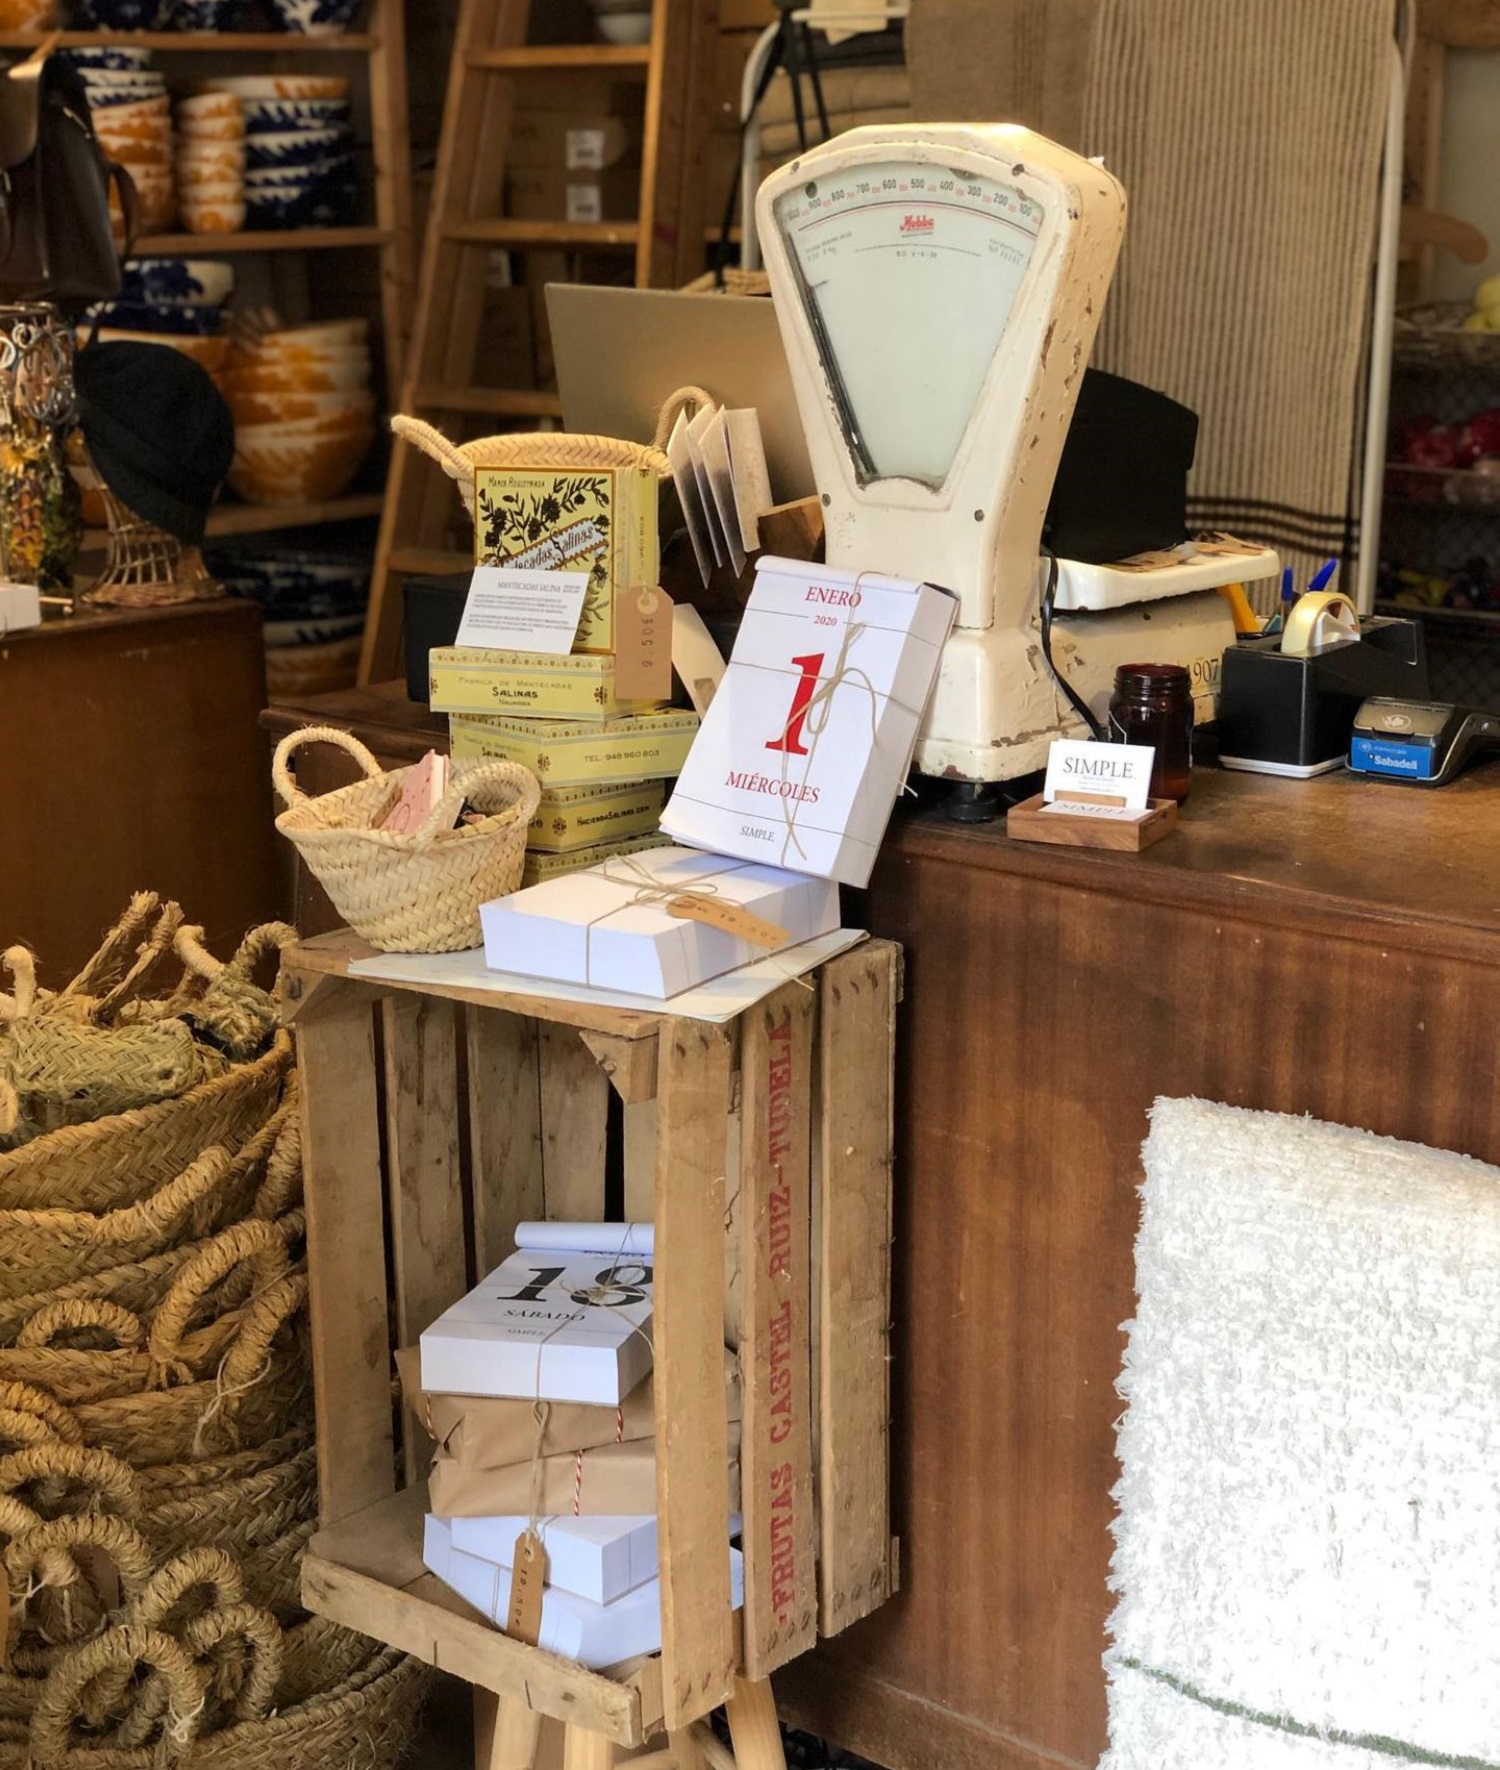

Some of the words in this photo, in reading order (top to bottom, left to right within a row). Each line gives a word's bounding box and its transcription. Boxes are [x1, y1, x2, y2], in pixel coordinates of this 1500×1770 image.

[831, 189, 845, 202] 800
[856, 182, 870, 194] 700
[882, 179, 896, 190] 600
[911, 179, 925, 190] 500
[939, 181, 954, 192] 400
[967, 185, 982, 198] 300
[993, 193, 1008, 207] 200
[1019, 203, 1033, 217] 100
[804, 586, 862, 608] ENERO
[814, 614, 837, 627] 2020
[765, 652, 825, 756] 1
[605, 751, 623, 761] 948
[623, 750, 641, 760] 960
[642, 748, 660, 758] 803
[1374, 754, 1418, 770] Sabadell
[725, 771, 820, 804] MIÉRCOLES
[497, 1265, 654, 1308] 18
[769, 1299, 792, 1445] CASTEL
